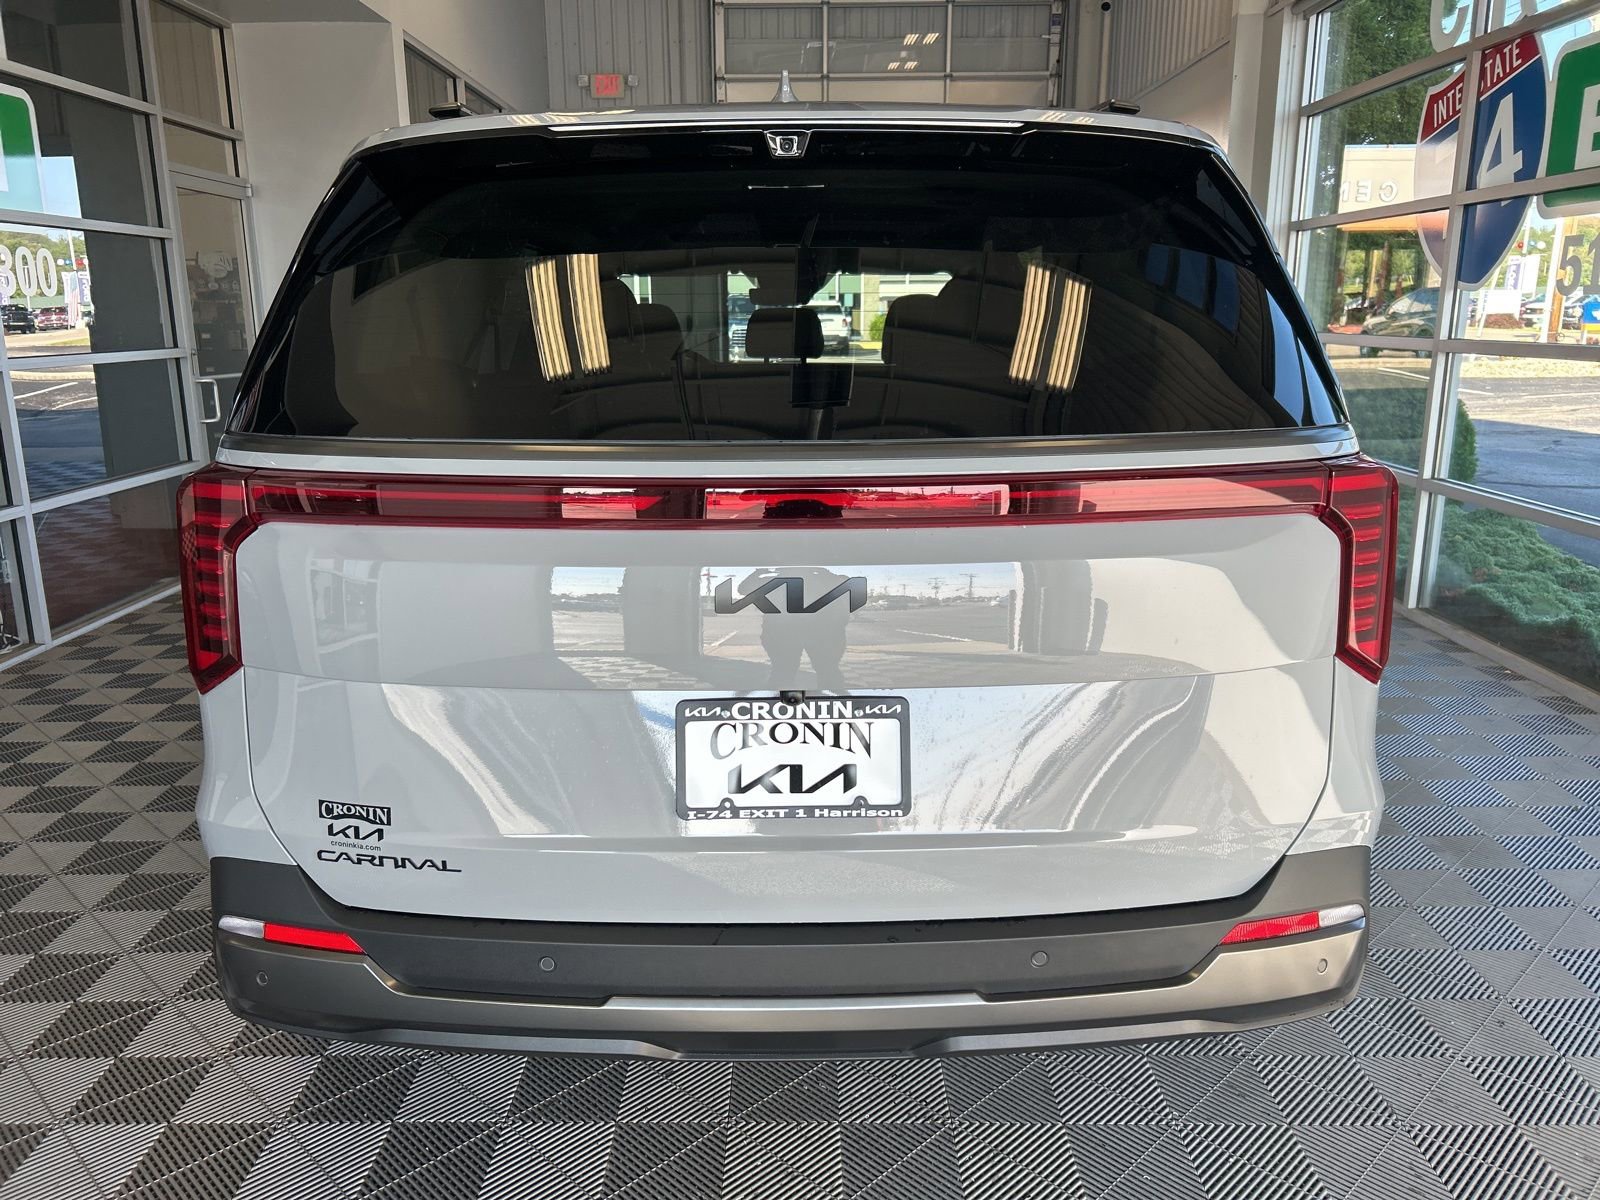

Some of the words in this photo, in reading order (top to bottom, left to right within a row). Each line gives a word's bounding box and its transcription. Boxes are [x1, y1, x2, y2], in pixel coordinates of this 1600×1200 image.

[1433, 38, 1523, 129] INTETATE
[714, 576, 868, 614] KIA
[684, 707, 721, 717] KIA
[731, 700, 853, 720] CRONIN
[865, 704, 902, 714] KIA
[710, 721, 875, 760] CRONIN
[727, 763, 857, 794] KIA
[321, 801, 388, 825] CRONIN
[687, 809, 733, 820] I-74
[739, 808, 789, 818] EXIT
[795, 808, 808, 818] 1
[814, 807, 904, 818] Harrison
[327, 822, 384, 842] KIA
[330, 840, 382, 852] croninkia.com
[317, 849, 463, 873] CARNIVAL
